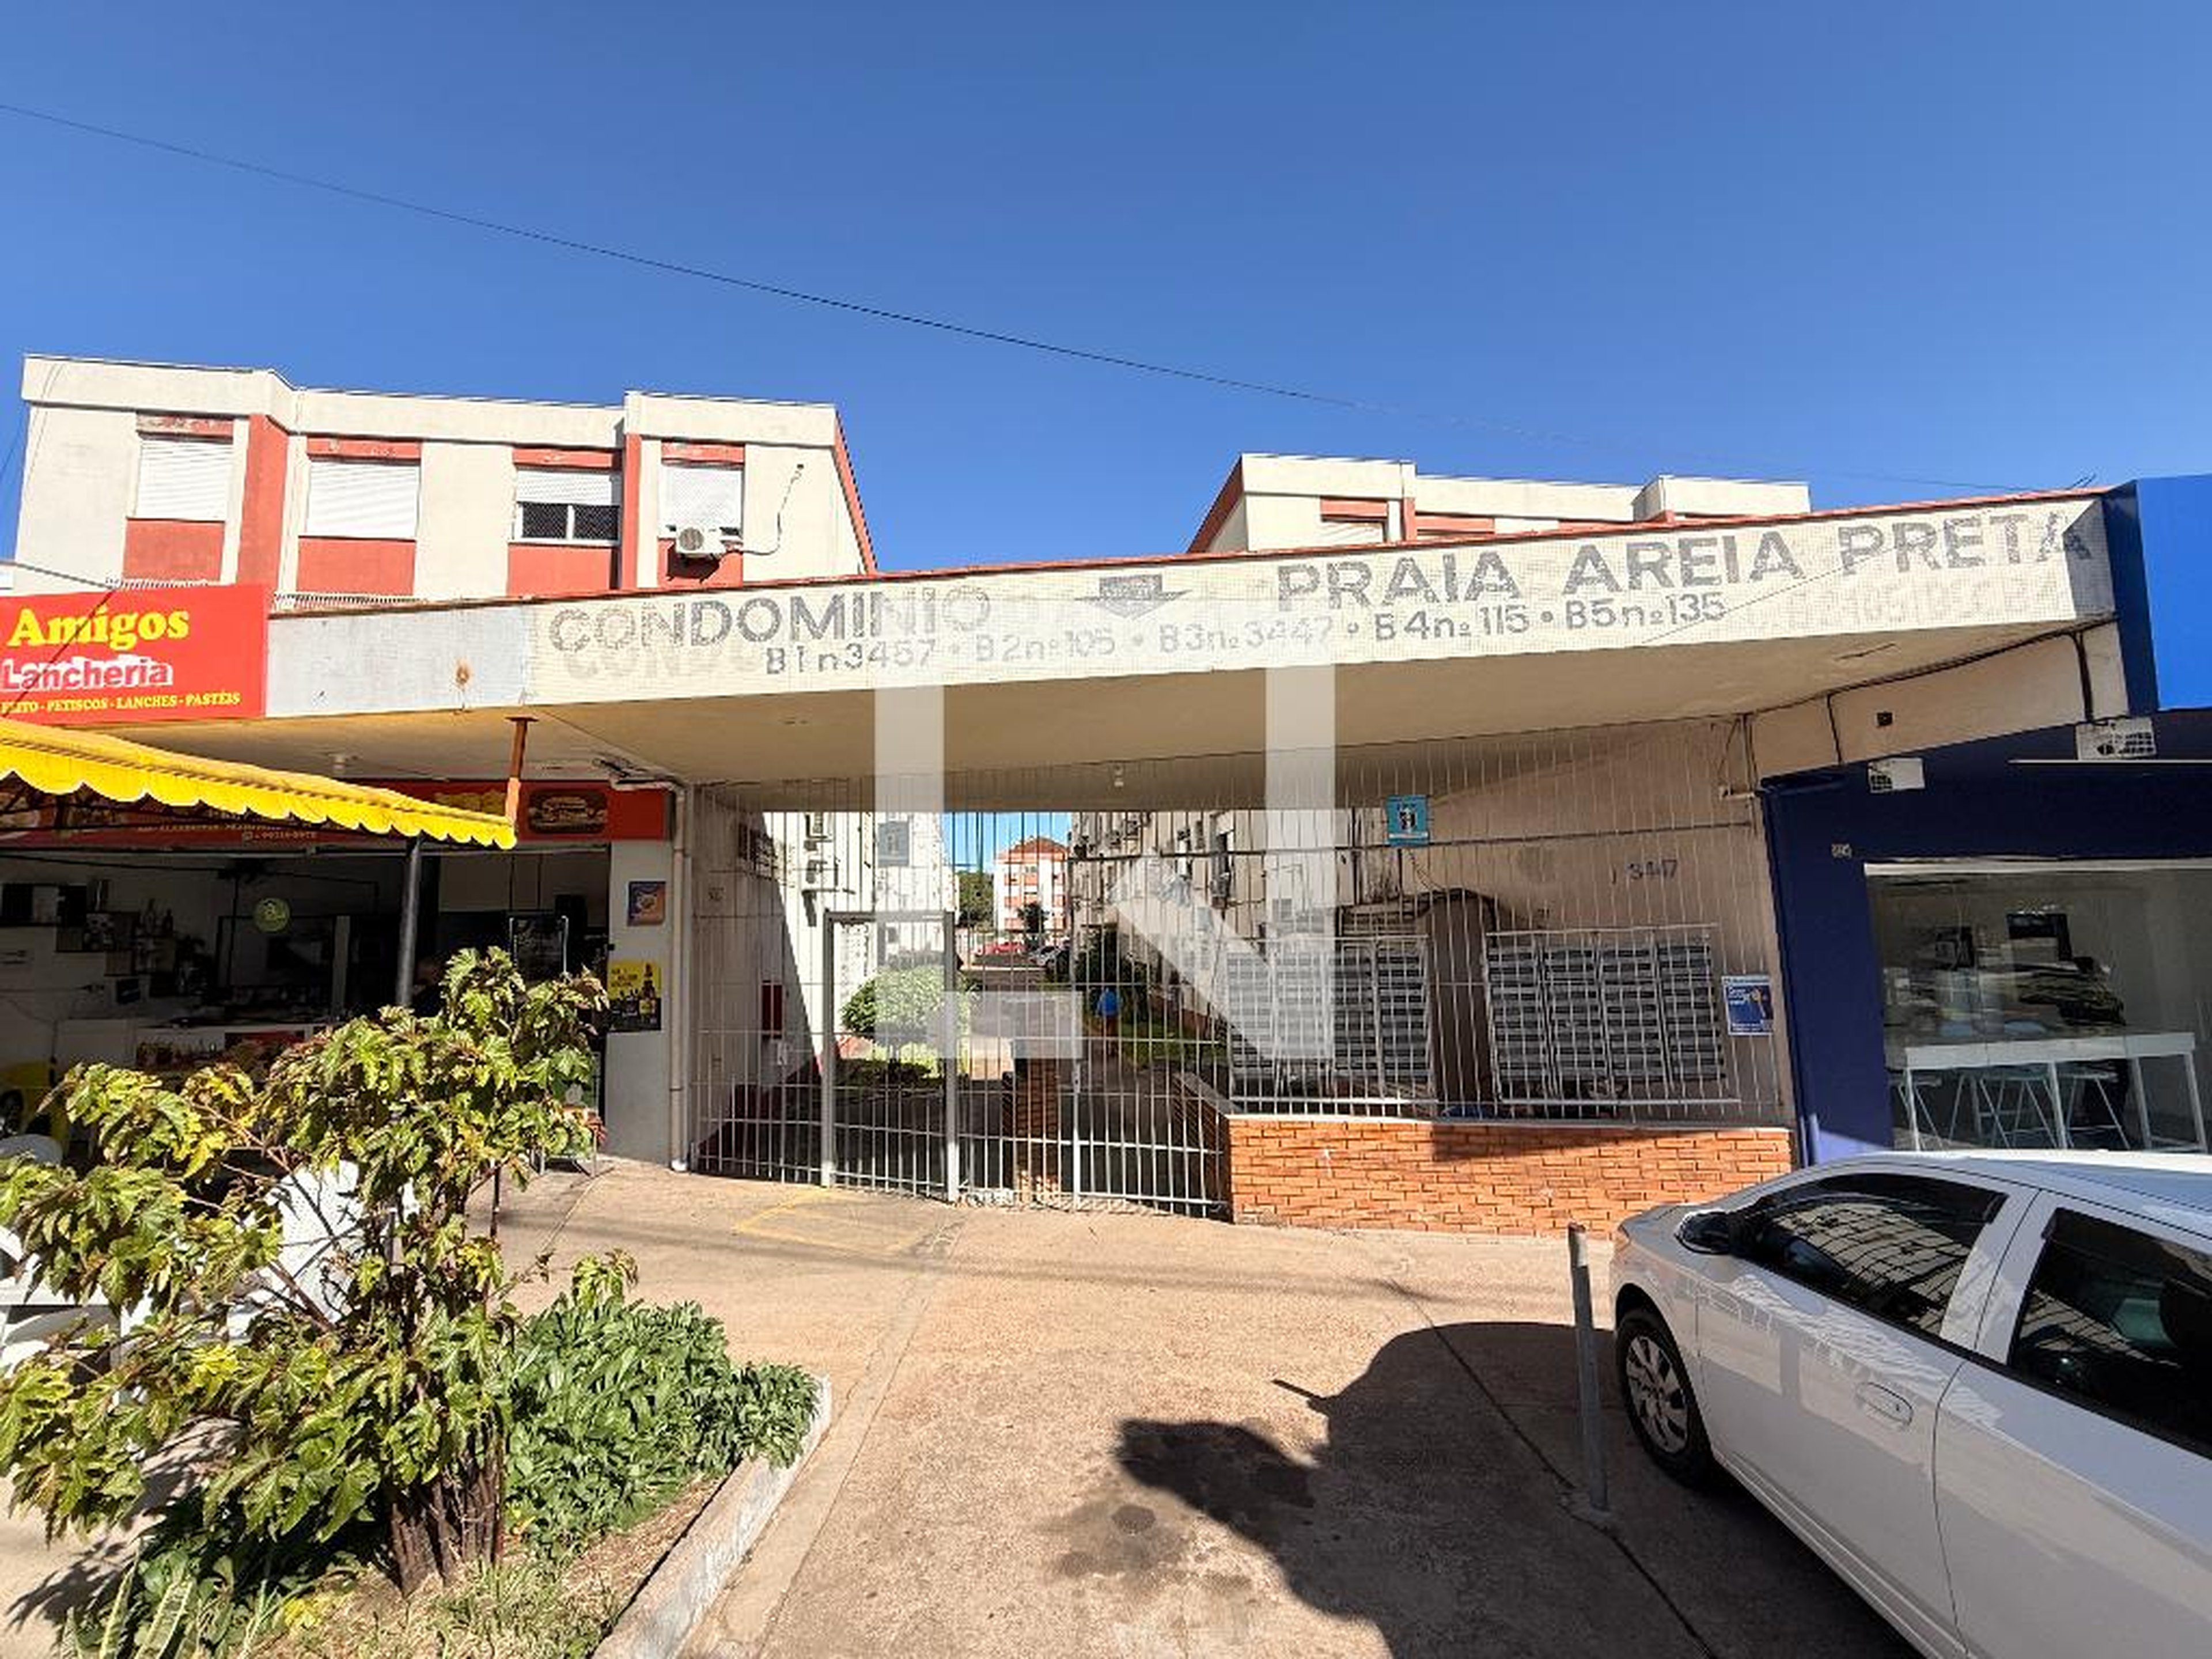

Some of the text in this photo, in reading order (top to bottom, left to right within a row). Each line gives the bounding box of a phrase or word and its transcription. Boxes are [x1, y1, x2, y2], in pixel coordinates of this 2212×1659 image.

[549, 512, 2091, 652] CONDOMINIO PRAIA AREIA PRETA
[7, 604, 190, 651] Amigos
[2, 657, 171, 690] Lancheria
[47, 698, 108, 711] PETISCOS
[116, 694, 176, 709] LANCHES
